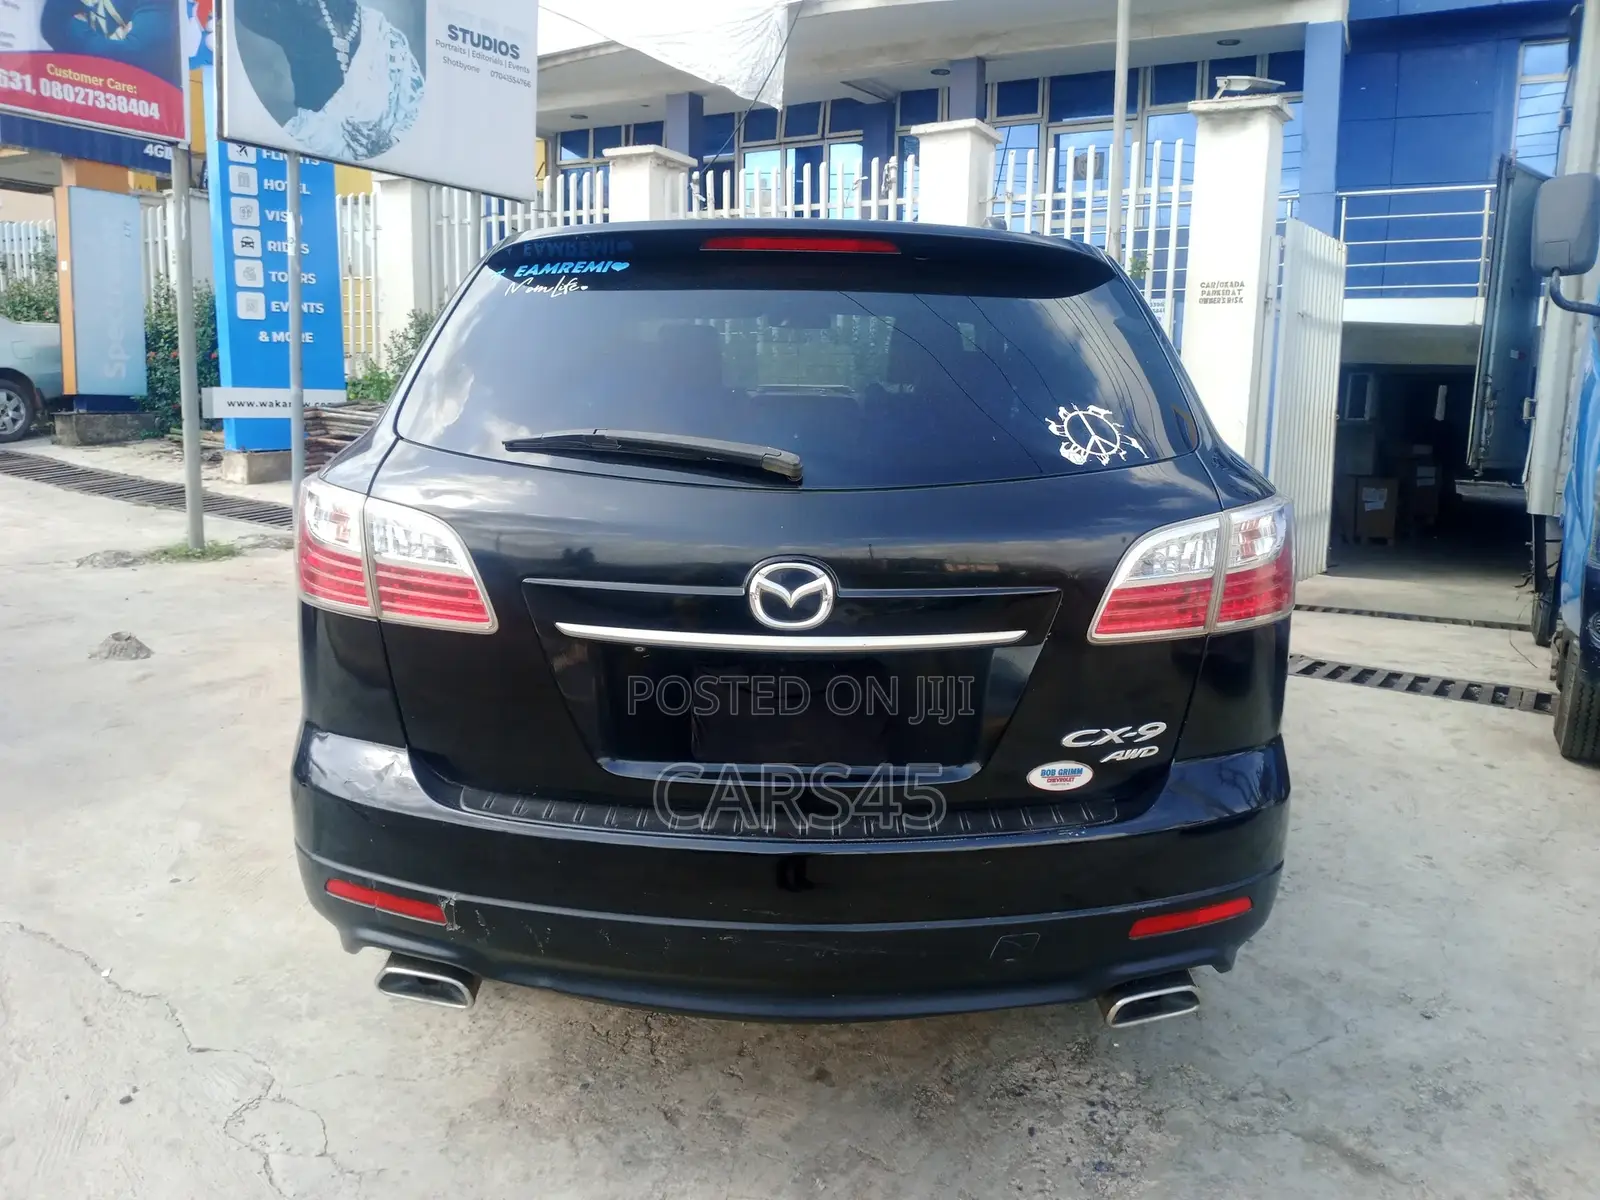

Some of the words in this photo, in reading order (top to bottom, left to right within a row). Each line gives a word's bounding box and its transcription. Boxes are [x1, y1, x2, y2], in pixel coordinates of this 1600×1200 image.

[447, 24, 520, 60] STUDIOS
[435, 39, 467, 55] Portraits
[471, 50, 504, 66] Editorials
[508, 61, 530, 74] Events
[46, 63, 104, 85] Customer
[106, 78, 137, 94] Care:
[40, 78, 160, 120] 08027338404
[262, 148, 320, 166] FLITS
[263, 179, 311, 195] HOL
[265, 209, 303, 226] VIS
[267, 240, 310, 254] RIDS
[268, 271, 317, 285] TORS
[271, 301, 325, 314] EVNTS
[258, 331, 270, 343] &
[1061, 721, 1167, 748] CX-9
[1100, 745, 1159, 763] AWD
[1040, 768, 1057, 777] BOB
[1058, 767, 1083, 776] GRIMM
